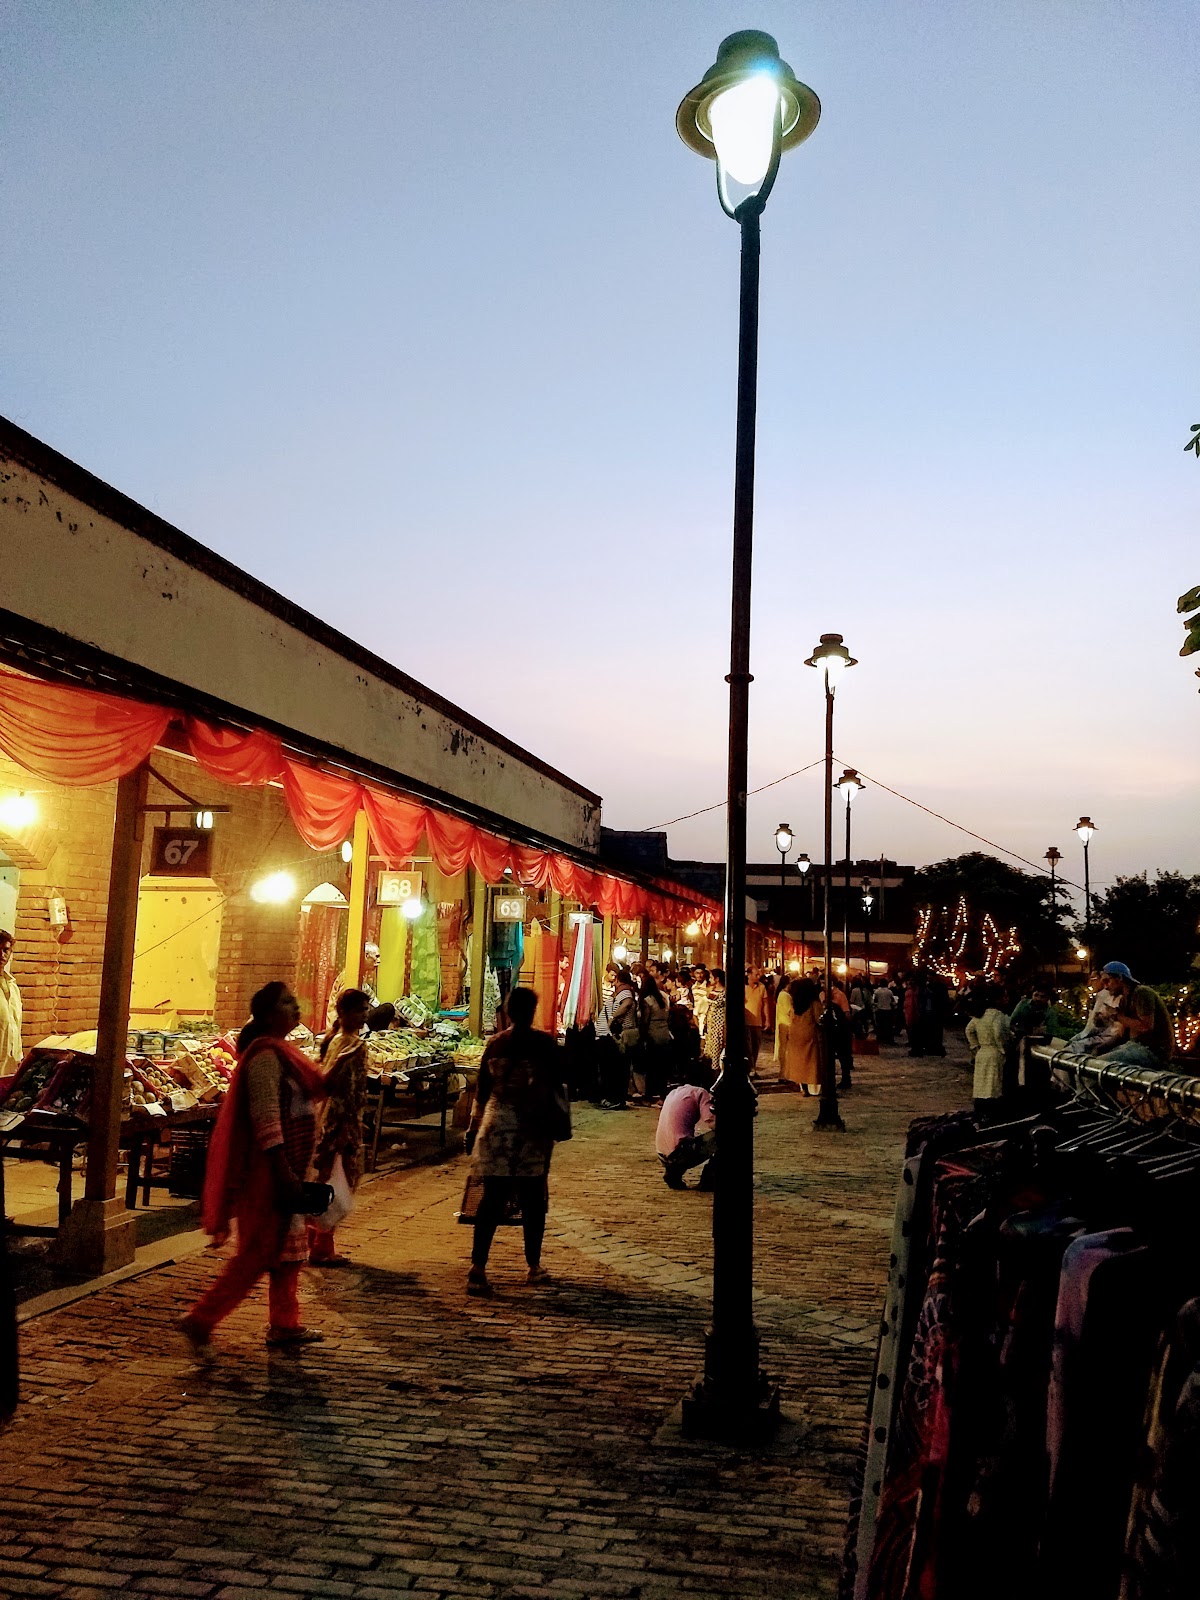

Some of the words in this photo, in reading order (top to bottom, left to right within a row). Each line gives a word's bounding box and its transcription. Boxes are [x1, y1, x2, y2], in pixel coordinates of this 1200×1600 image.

[164, 840, 199, 865] 67
[387, 878, 412, 898] 68
[500, 901, 521, 917] 69
